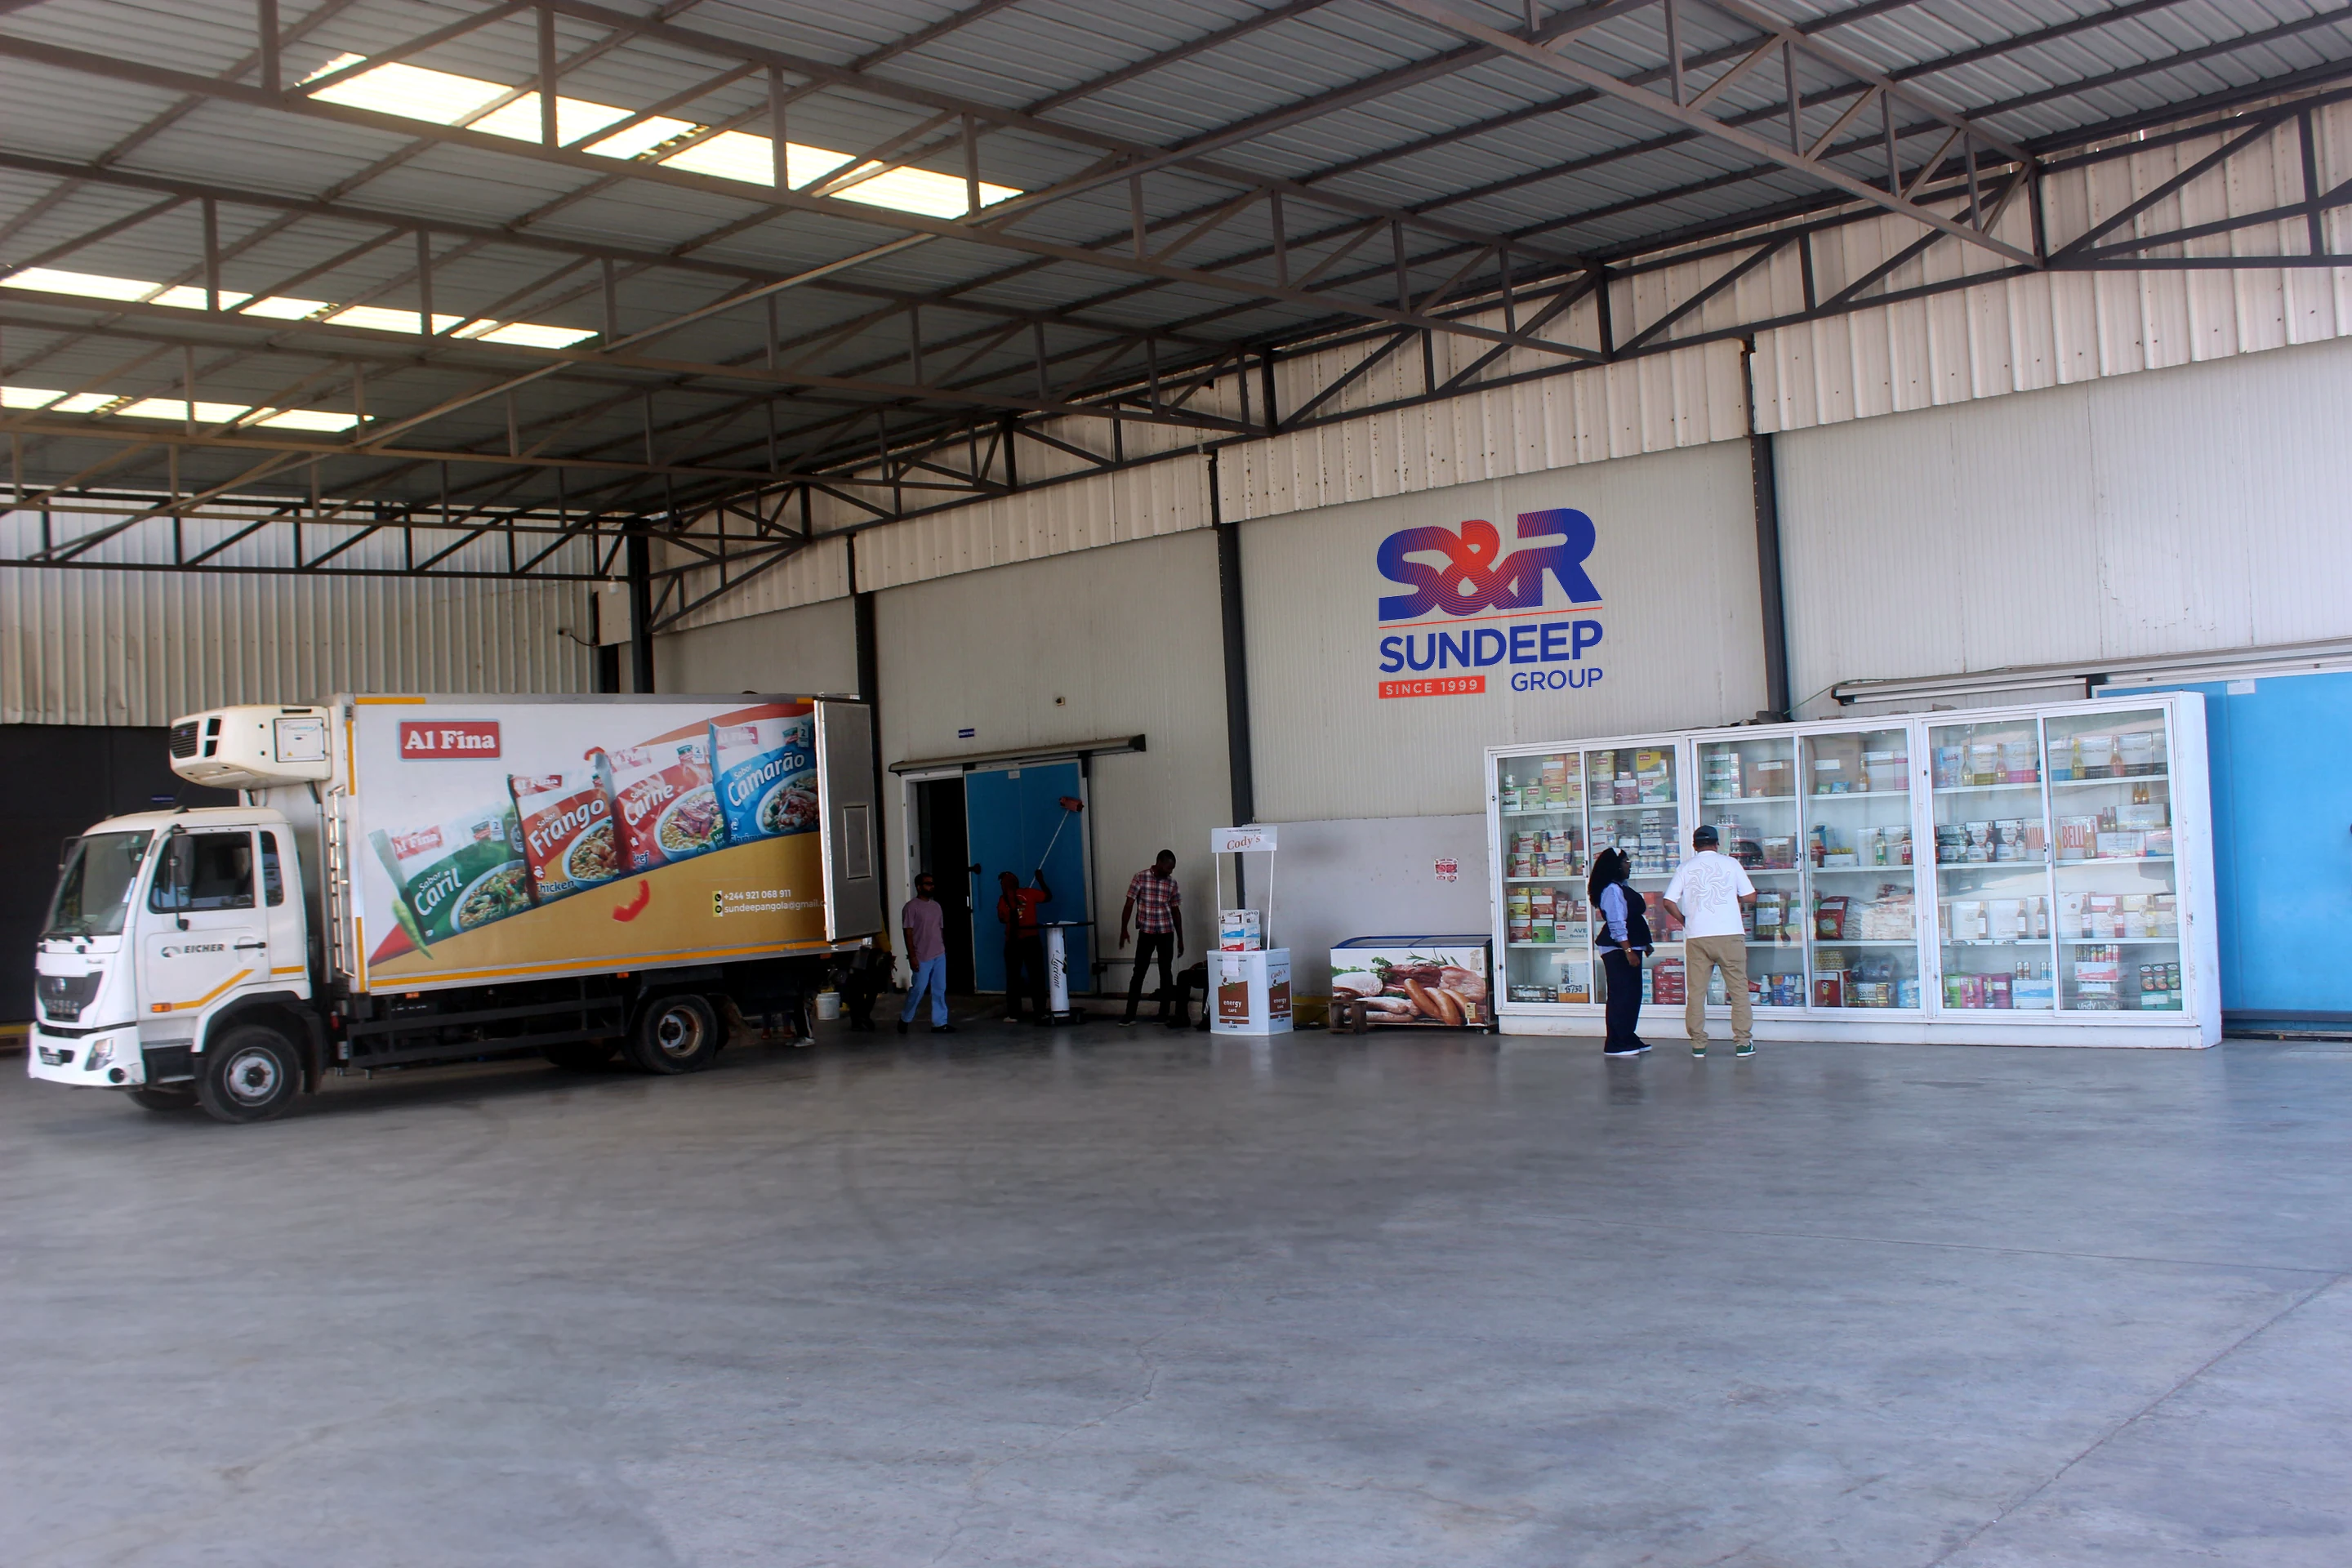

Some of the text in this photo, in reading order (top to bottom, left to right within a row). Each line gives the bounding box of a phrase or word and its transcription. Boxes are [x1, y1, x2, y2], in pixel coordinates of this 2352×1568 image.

[1377, 508, 1602, 621] S&R
[1379, 620, 1603, 673] SUNDEEP
[1386, 679, 1478, 695] SINCE 1999
[1511, 668, 1603, 691] GROUP
[404, 730, 496, 750] Al Fina
[728, 751, 805, 807] Camarão
[623, 784, 675, 826] Carne
[528, 800, 605, 858] Frango
[536, 812, 556, 829] Sabor
[1227, 835, 1262, 850] Cody's
[414, 867, 462, 915] Caril
[418, 871, 442, 892] Sabor
[724, 889, 791, 901] +244 921 068 911
[184, 943, 225, 954] EICHER
[1223, 1000, 1242, 1009] energy
